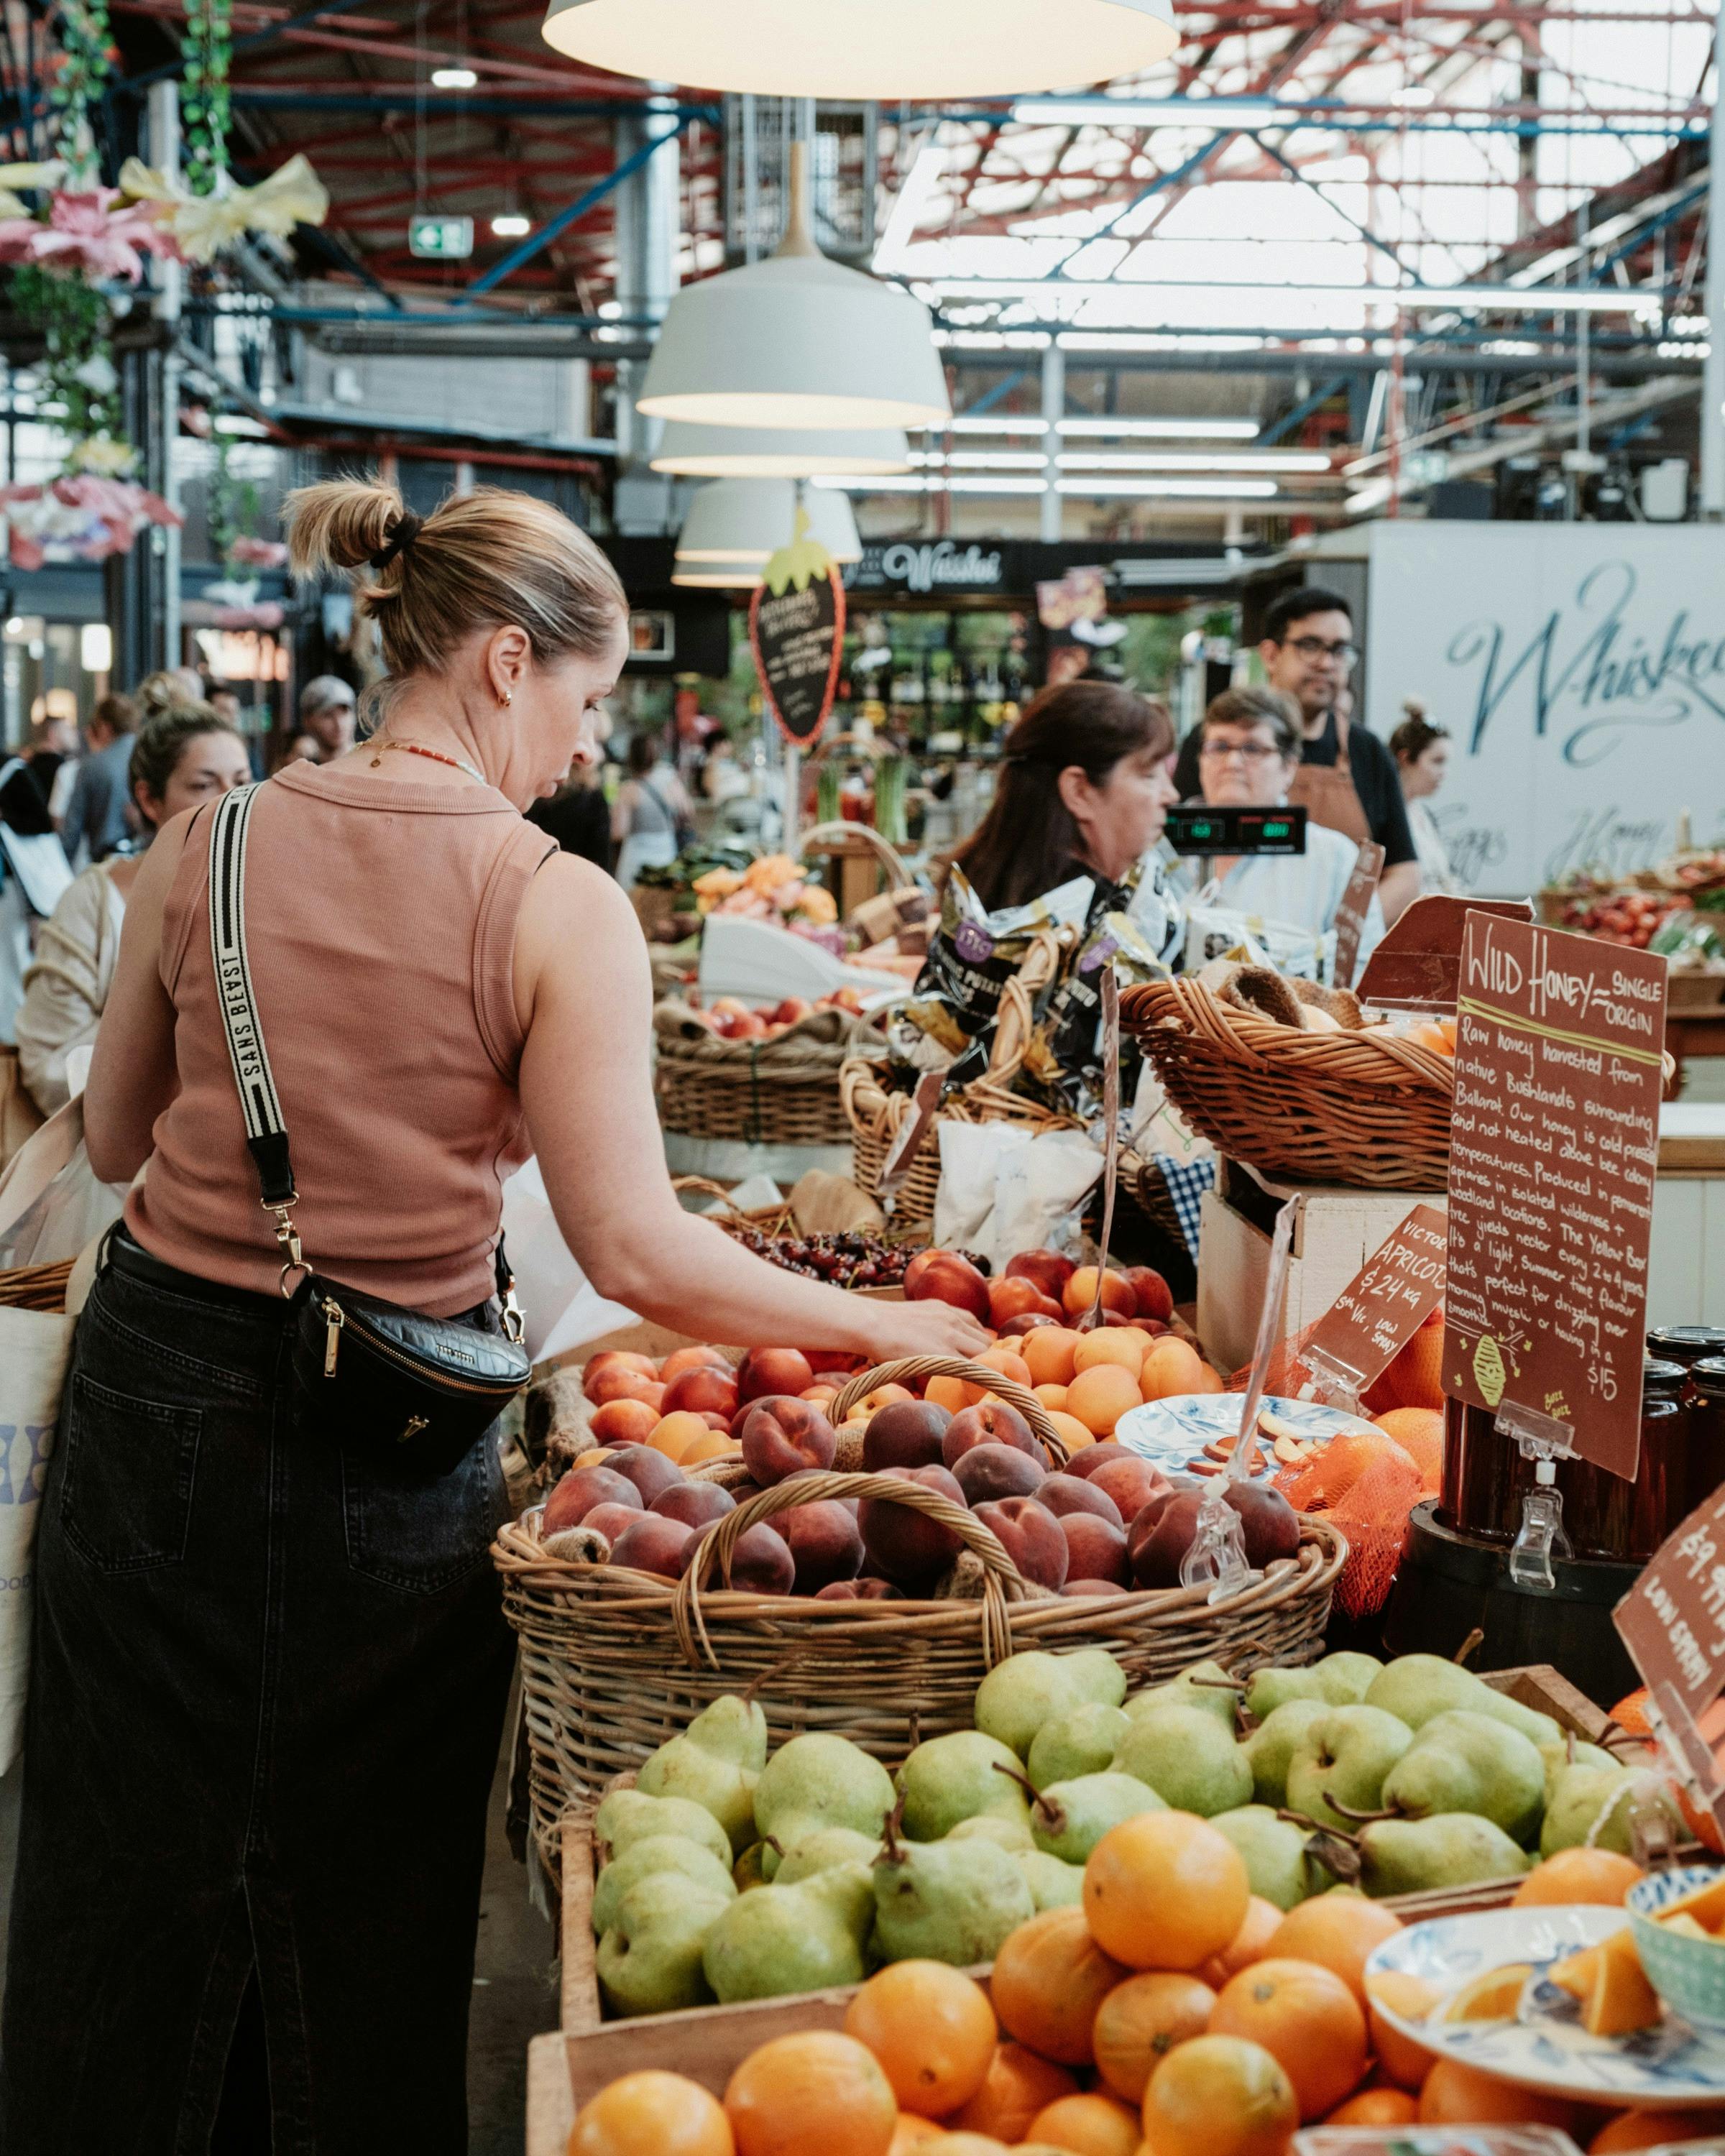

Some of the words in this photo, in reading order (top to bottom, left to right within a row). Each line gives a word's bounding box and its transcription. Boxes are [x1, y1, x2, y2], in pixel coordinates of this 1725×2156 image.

[221, 957, 249, 1018] BEAST
[1468, 922, 1523, 995] WILD
[1528, 929, 1595, 1020] HONEY
[1611, 970, 1662, 1003] SINGLE
[234, 1023, 261, 1077] SANS
[1461, 1015, 1490, 1046] Raw
[1497, 1027, 1535, 1080] honey
[1543, 1038, 1603, 1076] harvested
[1607, 1056, 1644, 1087] from
[1605, 1002, 1653, 1036] ORIGIN
[1456, 1054, 1498, 1085] native
[1506, 1071, 1576, 1111] Bushlands
[1451, 1112, 1476, 1132] and
[1478, 1121, 1501, 1138] not
[1504, 1124, 1553, 1154] heated
[1558, 1140, 1595, 1167] above
[1598, 1153, 1621, 1176] bee
[1509, 1102, 1535, 1123] Our
[1543, 1112, 1577, 1151] honey
[1583, 1125, 1596, 1144] is
[1599, 1135, 1623, 1155] cold
[1450, 1135, 1533, 1179] temperatures.
[1534, 1160, 1591, 1197] Produced
[1597, 1180, 1609, 1202] in
[1450, 1164, 1492, 1187] apiaries
[1494, 1174, 1506, 1194] in
[1511, 1184, 1556, 1211] isolated
[1560, 1202, 1611, 1233] wilderness
[1449, 1186, 1496, 1212] woodland
[1559, 1222, 1584, 1247] The
[1588, 1233, 1624, 1262] Yellow
[1626, 1245, 1647, 1272] Box
[1449, 1202, 1471, 1225] tree
[1476, 1214, 1509, 1240] yields
[1558, 1248, 1588, 1281] every
[1592, 1262, 1602, 1279] 2
[1602, 1268, 1612, 1284] to
[1614, 1270, 1622, 1289] 4
[1359, 1265, 1404, 1303] $24
[1402, 1286, 1422, 1310] KG
[1448, 1254, 1478, 1279] that's
[1484, 1275, 1529, 1298] perfect
[1531, 1284, 1550, 1307] for
[1604, 1320, 1629, 1338] over
[1449, 1224, 1466, 1248] It's
[1473, 1240, 1481, 1253] a
[1569, 1274, 1593, 1300] time
[1598, 1287, 1637, 1317] flavour
[1371, 1331, 1400, 1357] SPRAY
[1374, 1317, 1399, 1335] LOW
[1447, 1280, 1486, 1317] morning
[1491, 1300, 1532, 1323] muesli
[1537, 1317, 1550, 1330] or
[1555, 1321, 1586, 1358] having
[1604, 1351, 1614, 1364] a
[1586, 1359, 1617, 1401] $15
